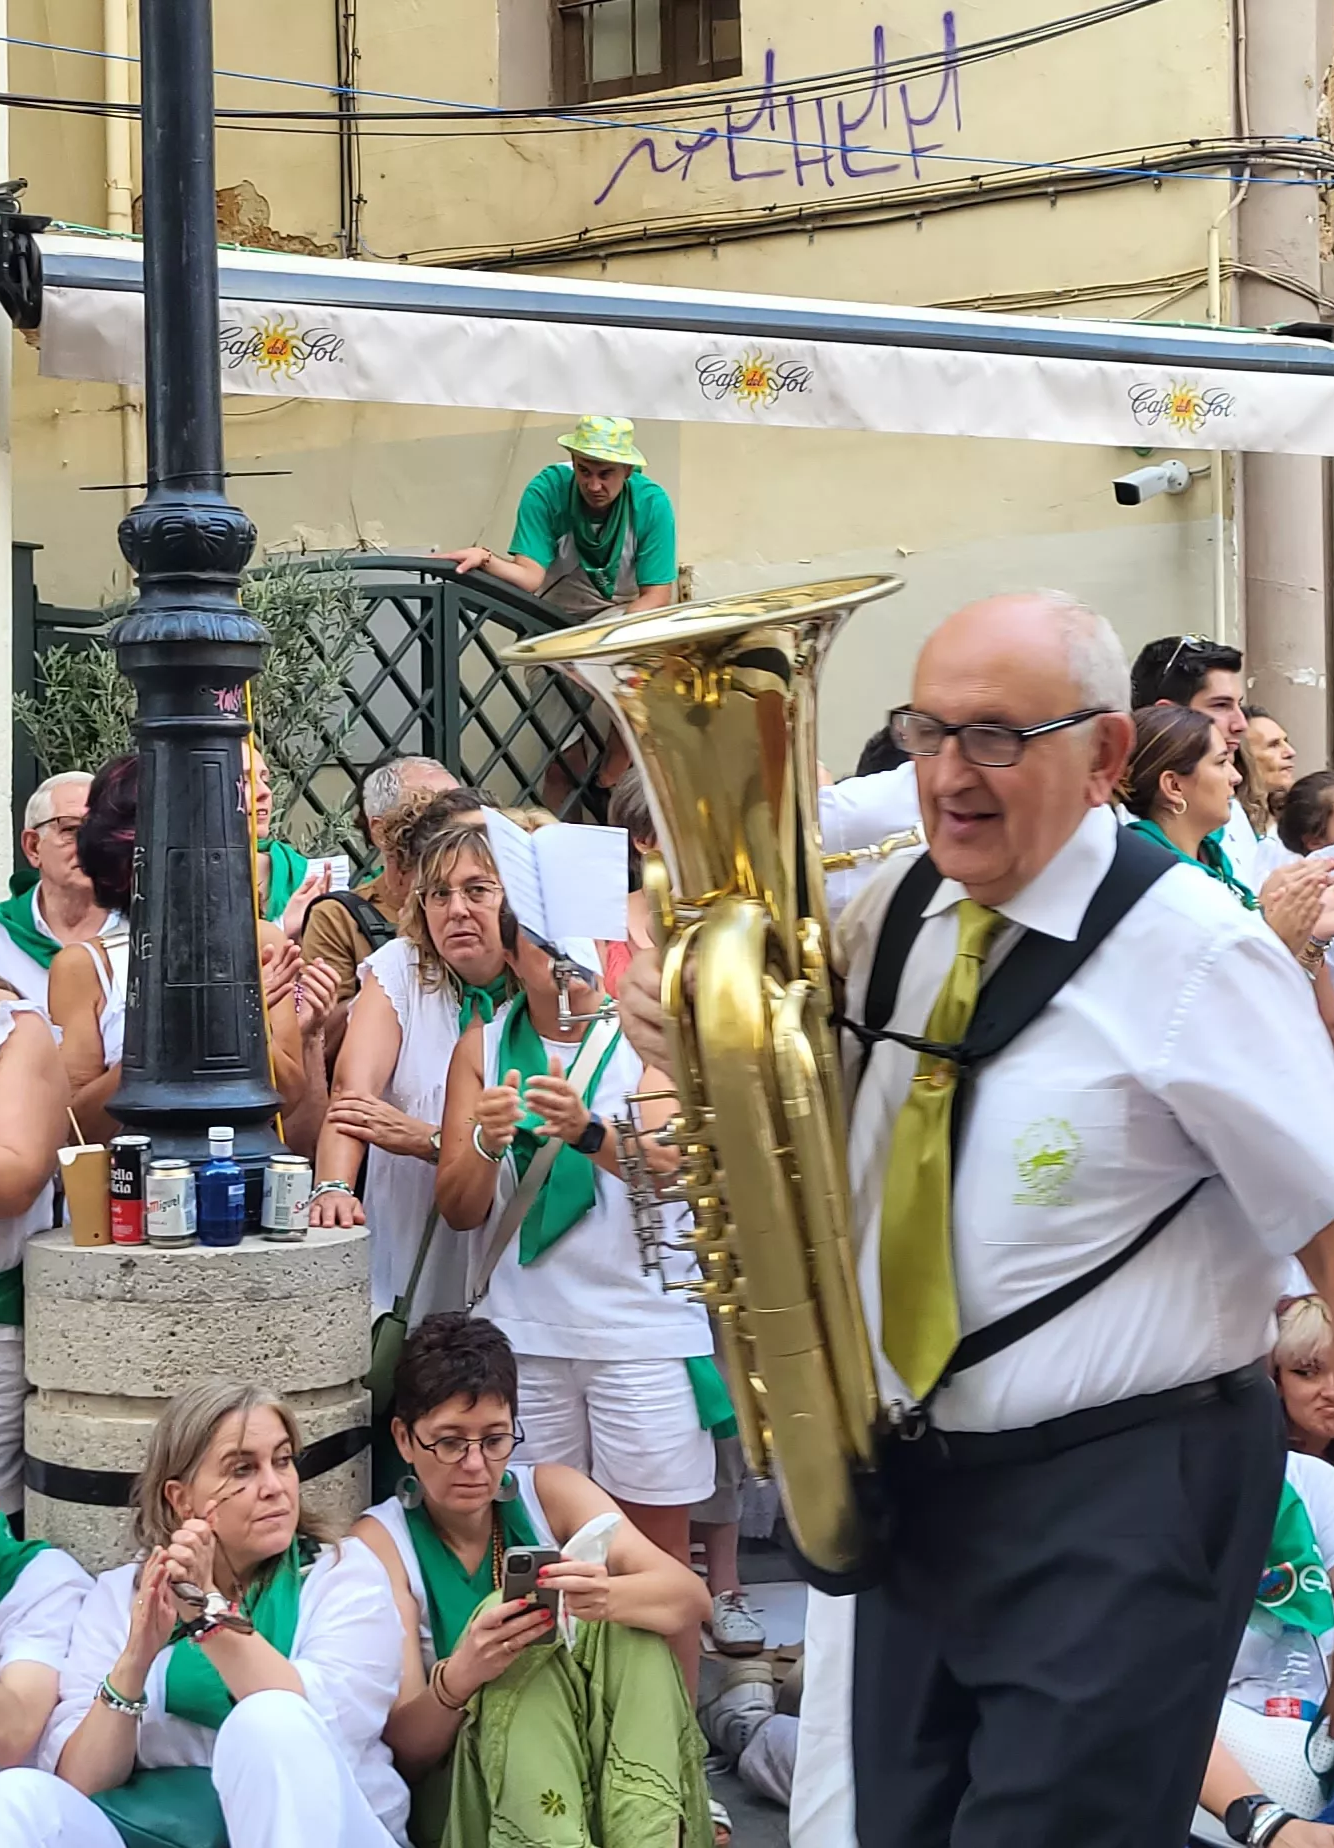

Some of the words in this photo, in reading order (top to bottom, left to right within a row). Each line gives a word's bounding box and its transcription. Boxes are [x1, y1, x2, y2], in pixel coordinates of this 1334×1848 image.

[291, 327, 345, 374] Sol
[695, 353, 748, 400] Café
[767, 360, 814, 404] Sol
[1193, 387, 1236, 429] Sol
